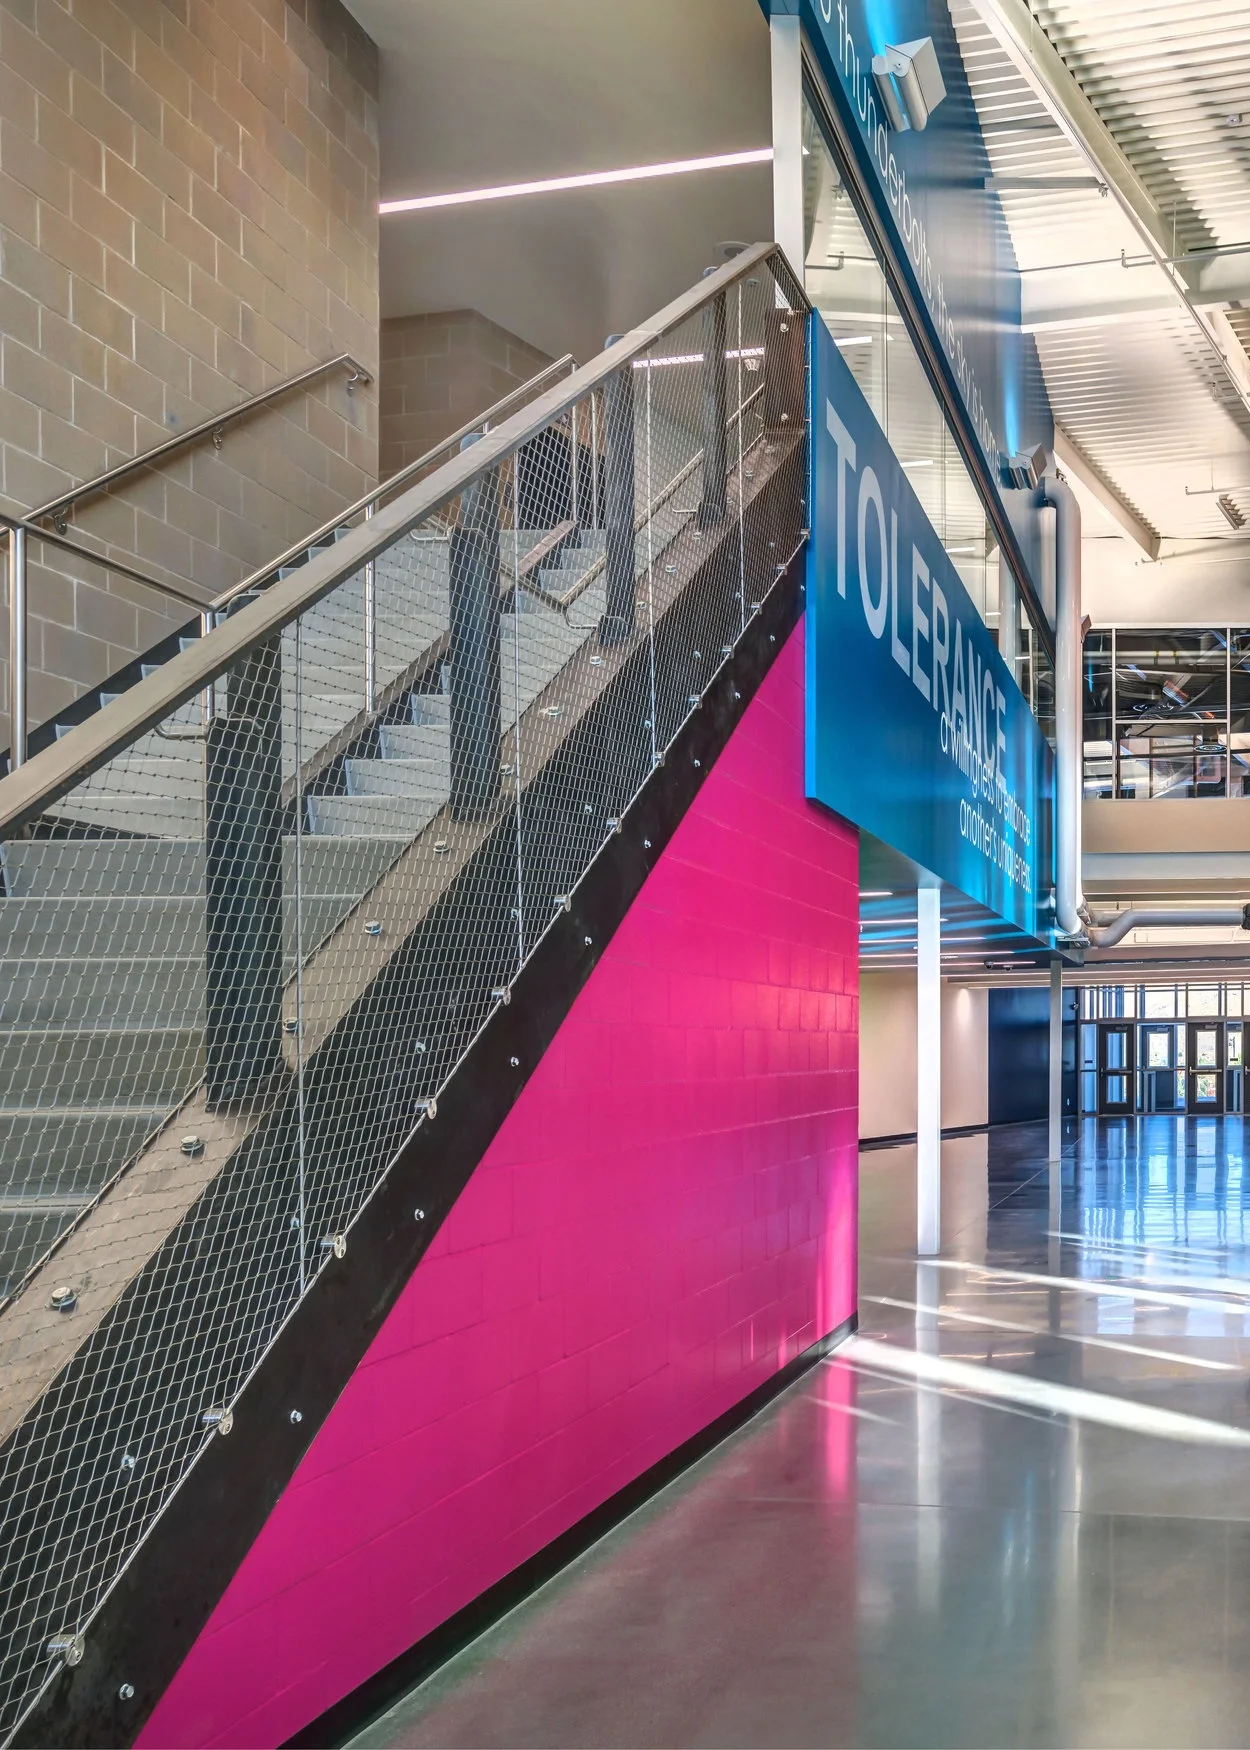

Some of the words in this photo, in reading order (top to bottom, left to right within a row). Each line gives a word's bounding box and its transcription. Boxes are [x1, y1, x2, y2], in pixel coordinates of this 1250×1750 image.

[938, 273, 956, 360] the
[956, 335, 973, 410] sky
[971, 367, 979, 424] is
[826, 396, 1007, 792] TOLERANCE
[940, 711, 949, 754] a
[949, 717, 995, 805] willingness
[994, 775, 1004, 815] to
[1004, 788, 1031, 847] embrace
[959, 798, 998, 864] another's
